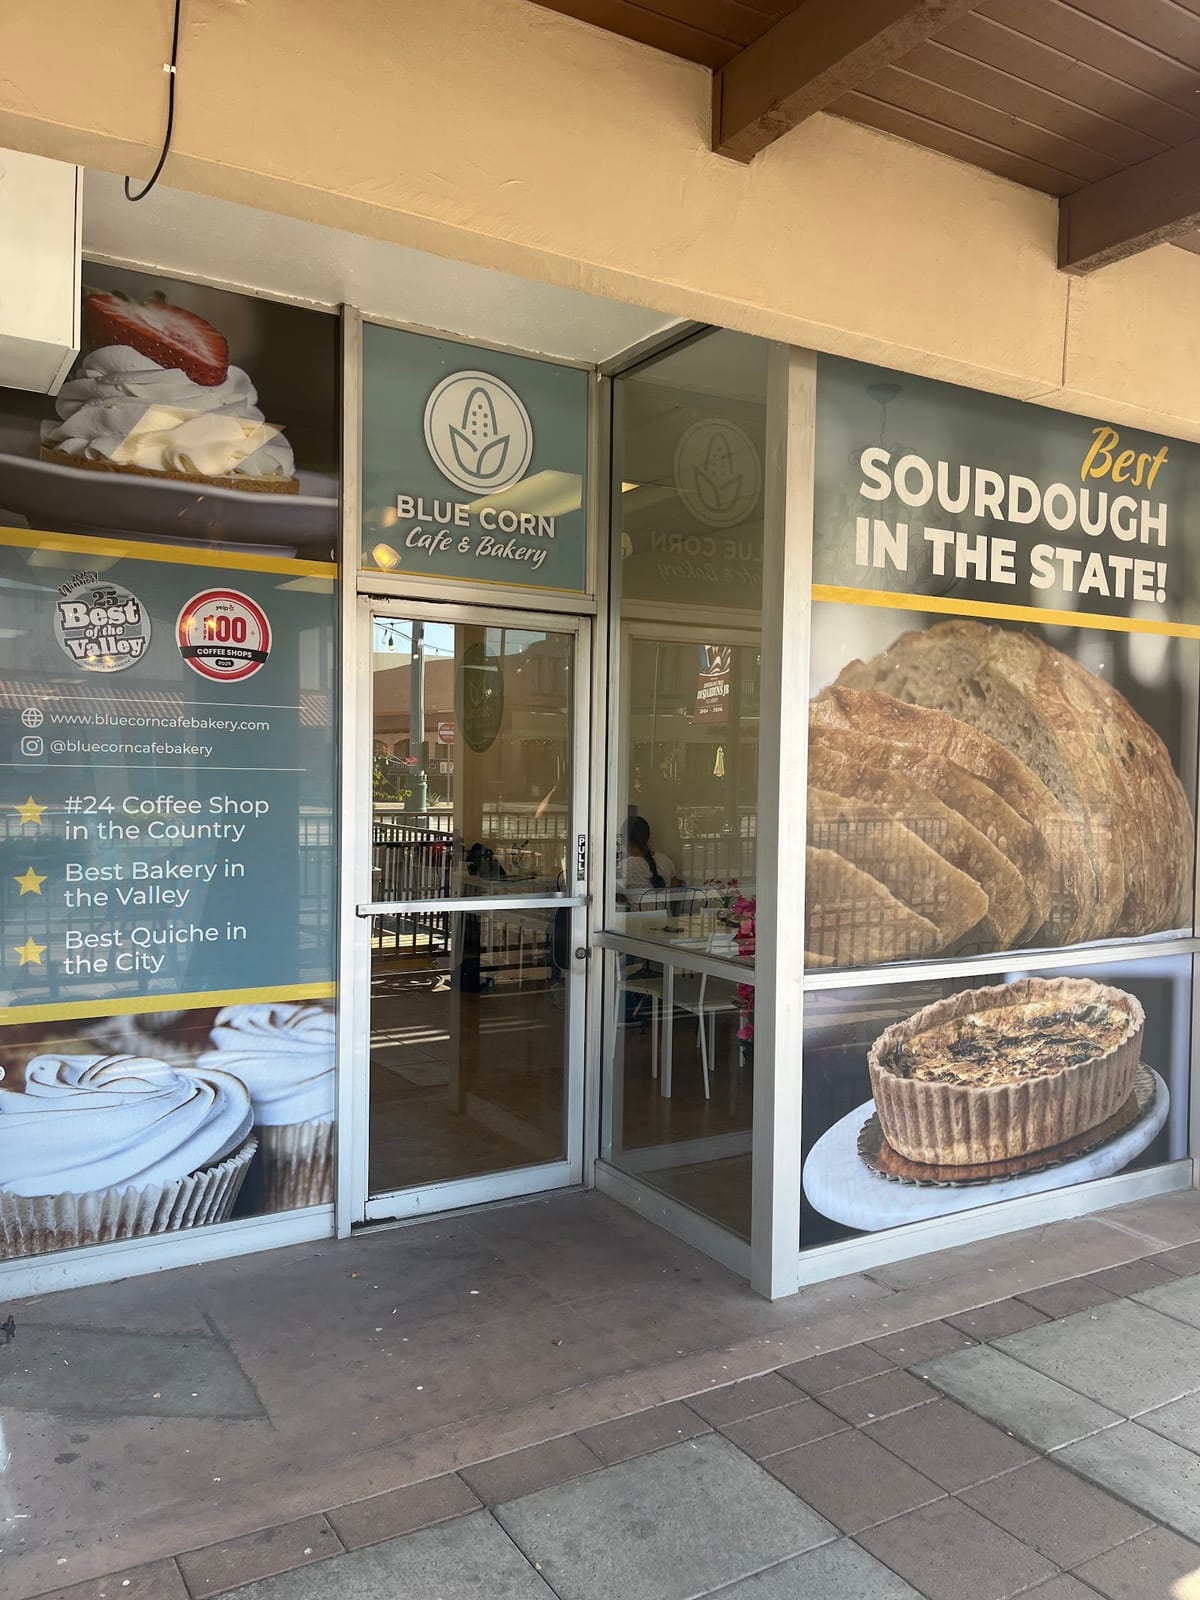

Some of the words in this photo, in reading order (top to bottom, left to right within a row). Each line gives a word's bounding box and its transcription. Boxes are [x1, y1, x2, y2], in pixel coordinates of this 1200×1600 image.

[1080, 426, 1169, 491] Best
[859, 447, 1168, 547] SOURDOUGH
[397, 494, 470, 527] BLUE
[479, 507, 556, 538] CORN
[405, 525, 450, 557] Cafe
[458, 537, 470, 553] &
[475, 535, 548, 570] Bakery
[855, 517, 909, 571] IN
[924, 527, 1017, 585] THE
[1029, 544, 1168, 604] STATE!
[58, 572, 98, 597] Winner!
[93, 591, 118, 606] 25
[59, 599, 140, 628] Best
[86, 626, 99, 638] of
[102, 625, 123, 636] the
[203, 615, 247, 643] 100
[67, 637, 143, 657] Valley
[197, 648, 225, 656] COFFEE
[227, 649, 252, 658] SHOPS
[50, 712, 270, 732] www.bluecorncafebakery.com
[50, 739, 213, 757] @bluecorncafebakery
[65, 796, 114, 815] #24
[122, 795, 201, 815] Coffee
[209, 795, 270, 819] Shop
[65, 820, 88, 840] in
[97, 819, 141, 840] the
[147, 819, 246, 843] Country
[66, 862, 123, 882] Best
[132, 860, 217, 883] Bakery
[224, 859, 245, 877] in
[64, 887, 108, 908] the
[115, 886, 190, 909] Valley
[66, 929, 123, 950] Best
[131, 923, 218, 948] Quiche
[226, 922, 247, 940] in
[64, 954, 107, 975] the
[115, 951, 165, 975] City
